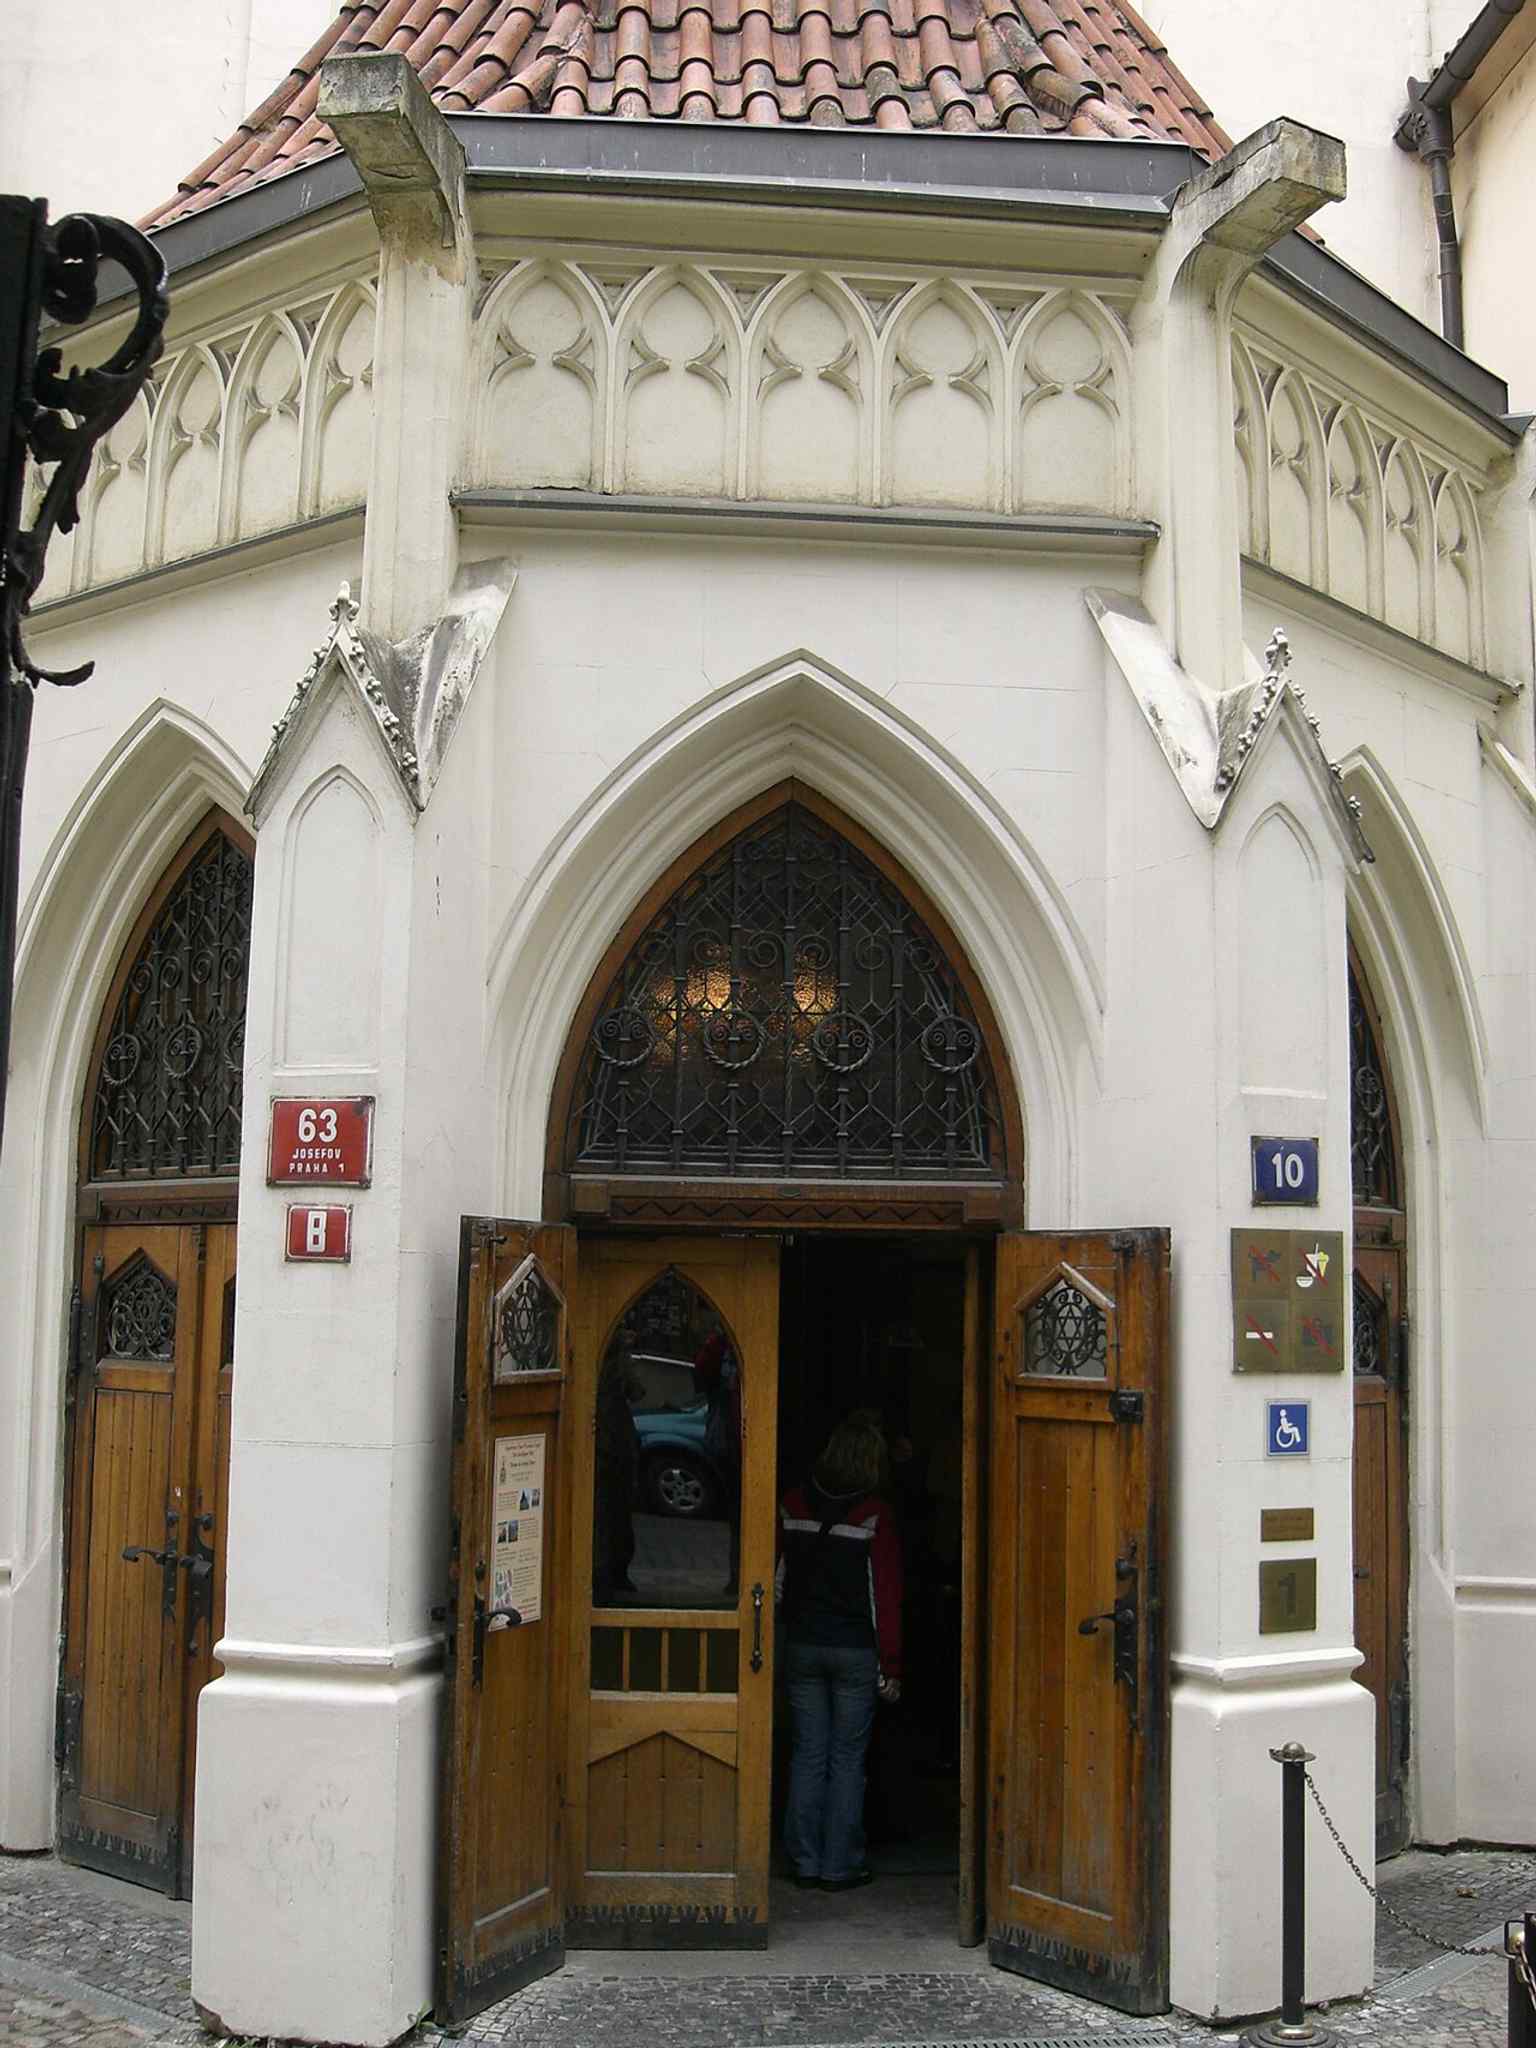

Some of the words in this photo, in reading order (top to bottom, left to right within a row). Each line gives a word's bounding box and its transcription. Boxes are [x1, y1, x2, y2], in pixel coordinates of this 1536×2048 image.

[298, 1108, 338, 1143] 63
[292, 1148, 341, 1160] JOSEFOV
[289, 1162, 328, 1173] PRAHA
[338, 1162, 345, 1173] 1
[1271, 1153, 1304, 1188] 10
